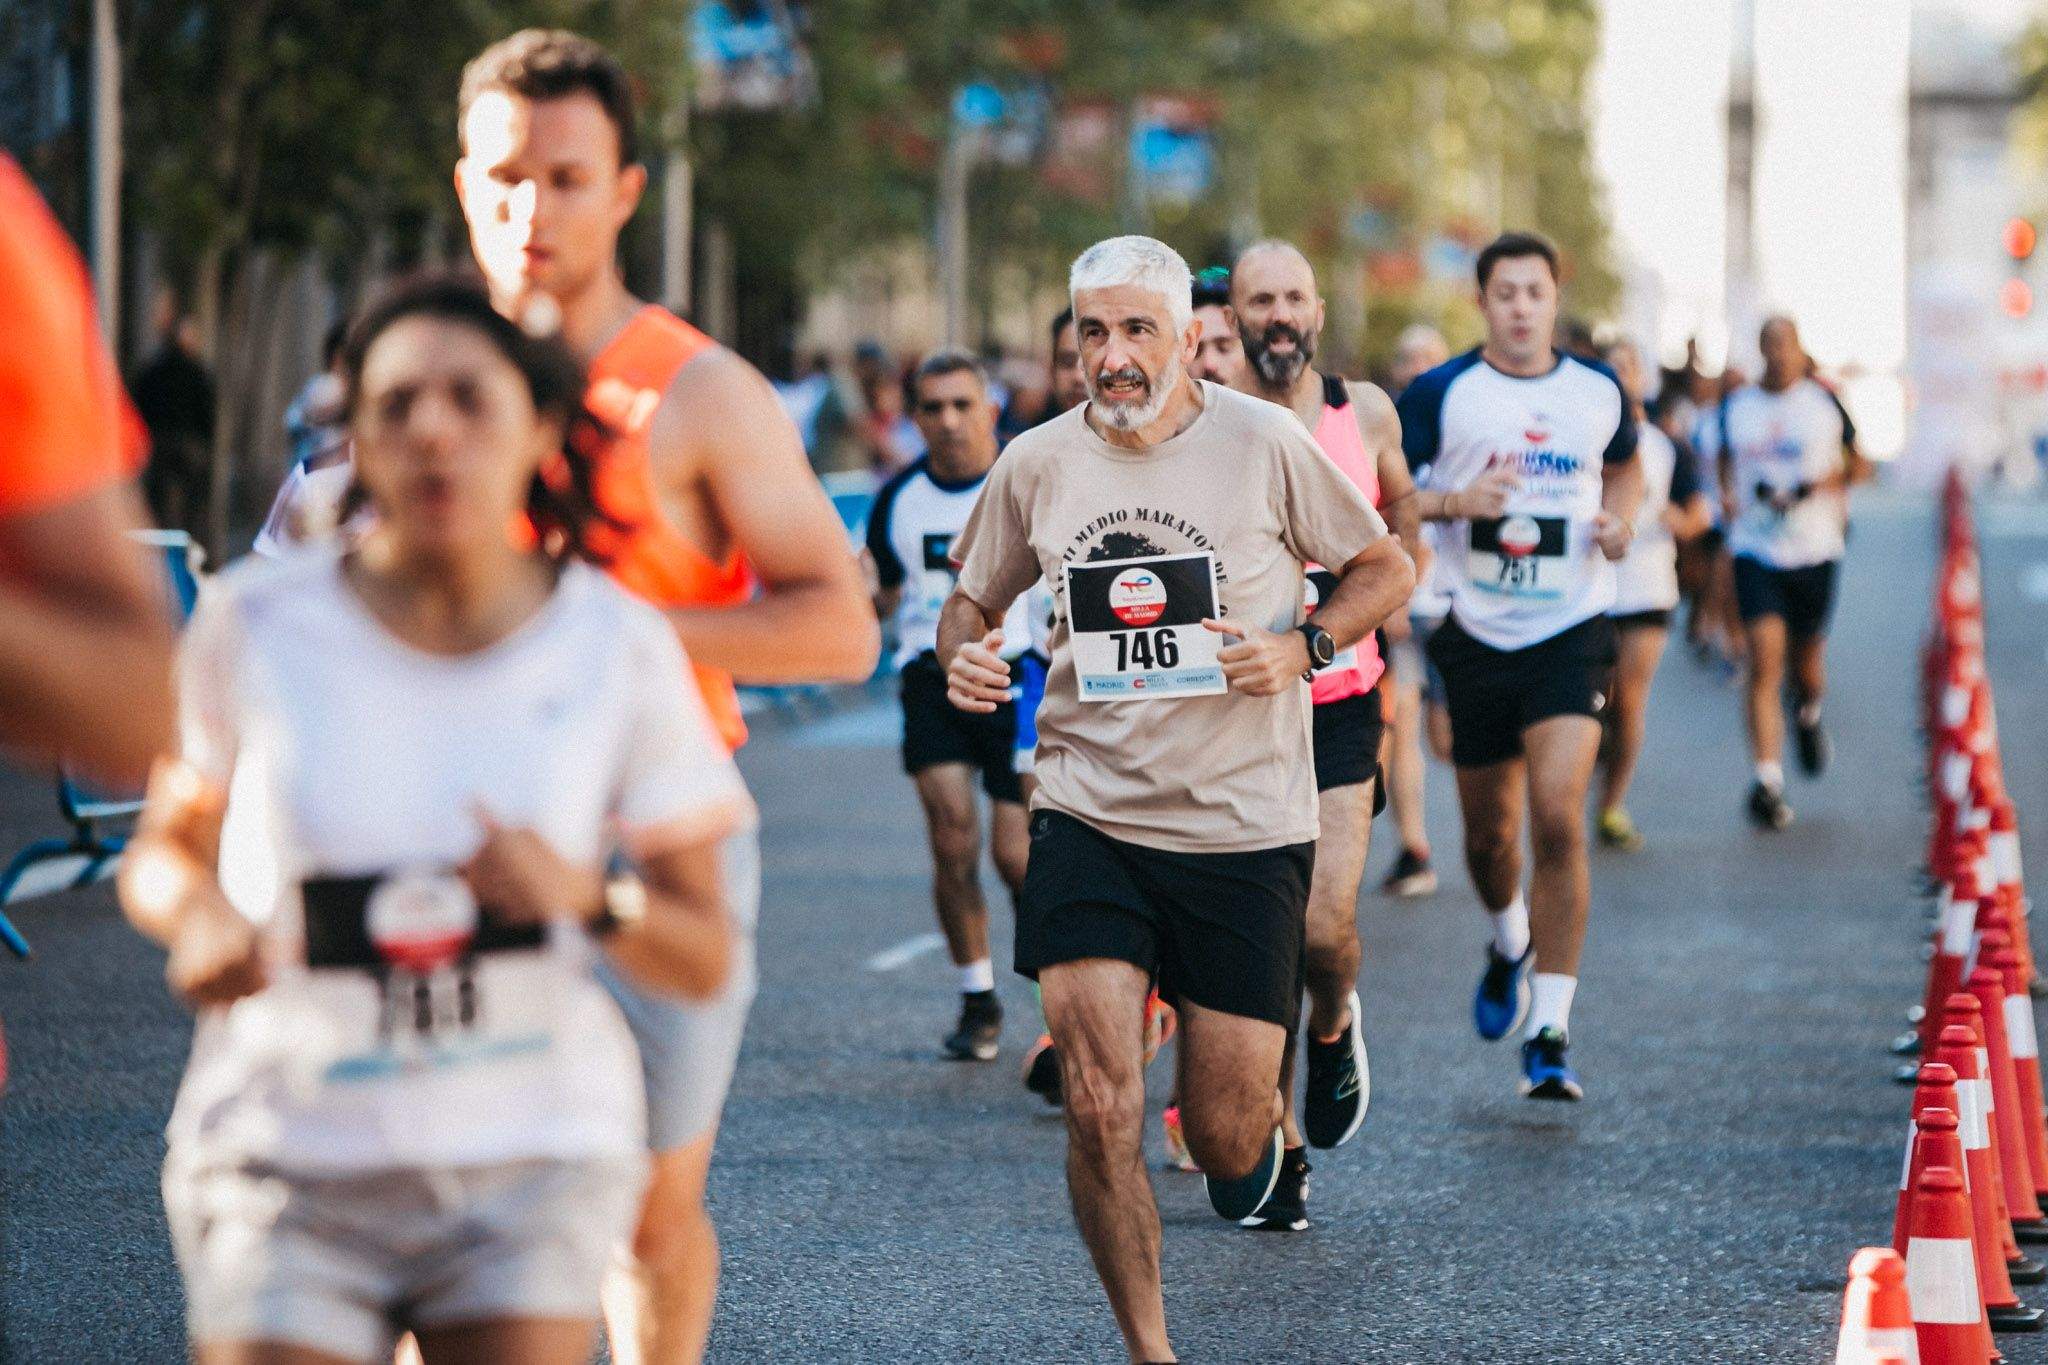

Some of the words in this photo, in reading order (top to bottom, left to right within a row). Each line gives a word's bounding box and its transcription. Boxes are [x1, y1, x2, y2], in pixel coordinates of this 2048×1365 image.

[1075, 509, 1128, 545] MEDIO
[1135, 507, 1214, 551] MARATO
[1109, 628, 1180, 672] 746
[1096, 681, 1125, 689] MADRID
